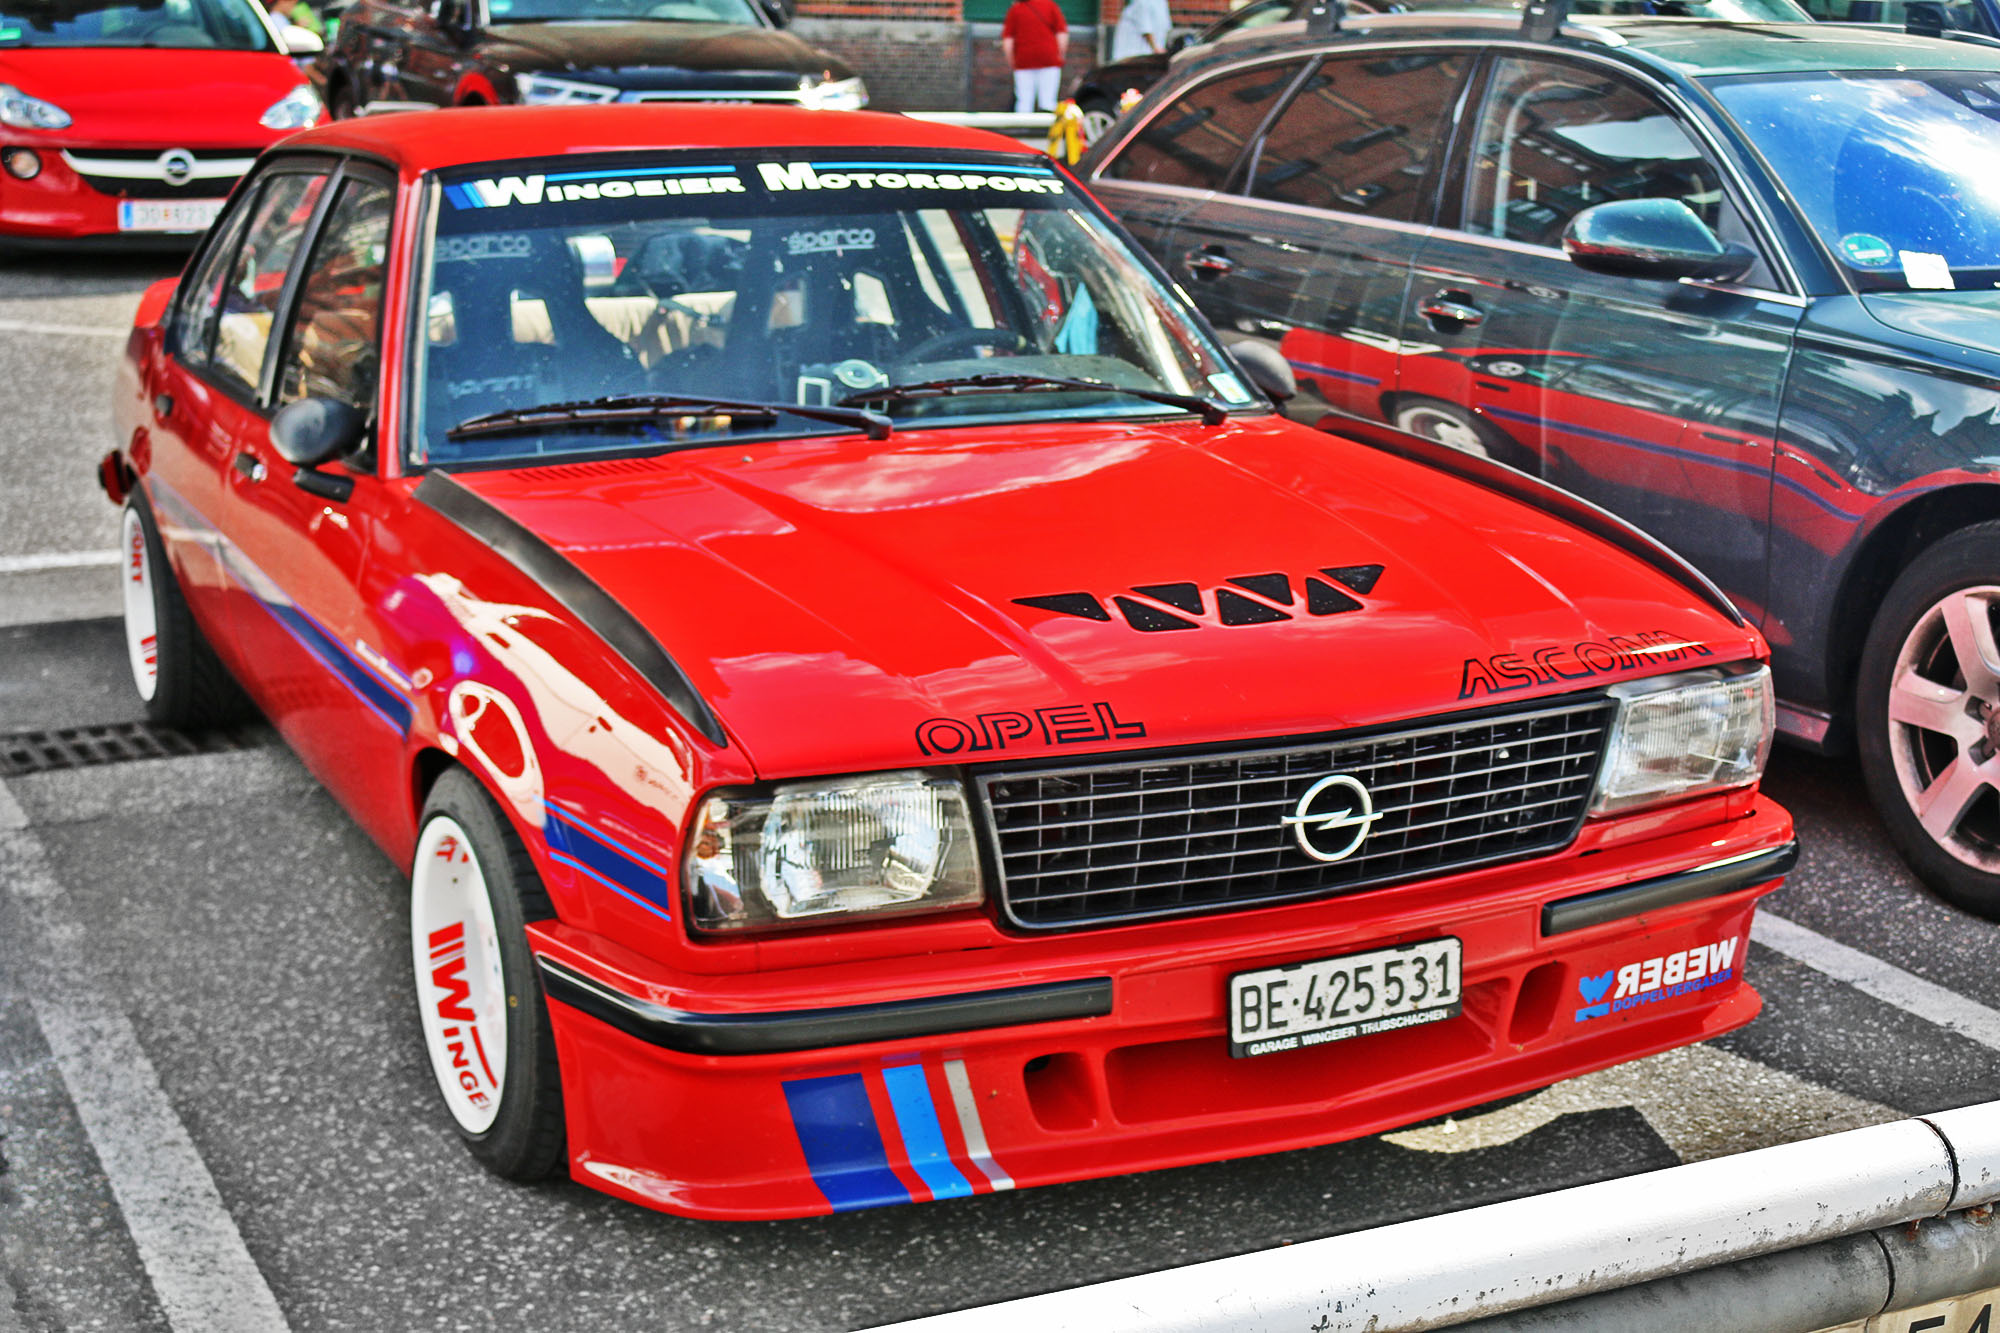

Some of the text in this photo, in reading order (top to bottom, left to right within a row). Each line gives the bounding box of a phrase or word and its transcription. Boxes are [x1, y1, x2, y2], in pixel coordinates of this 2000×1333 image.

[474, 162, 1064, 208] WINGEIER MOTORSPORT
[788, 228, 876, 251] sparco
[1458, 630, 1714, 700] ASCONA
[915, 702, 1147, 756] OPEL
[1612, 967, 1733, 1013] DOPPELVERGASER
[1250, 1008, 1449, 1056] GARAGE WINGEIER TRUBSCHACHEN
